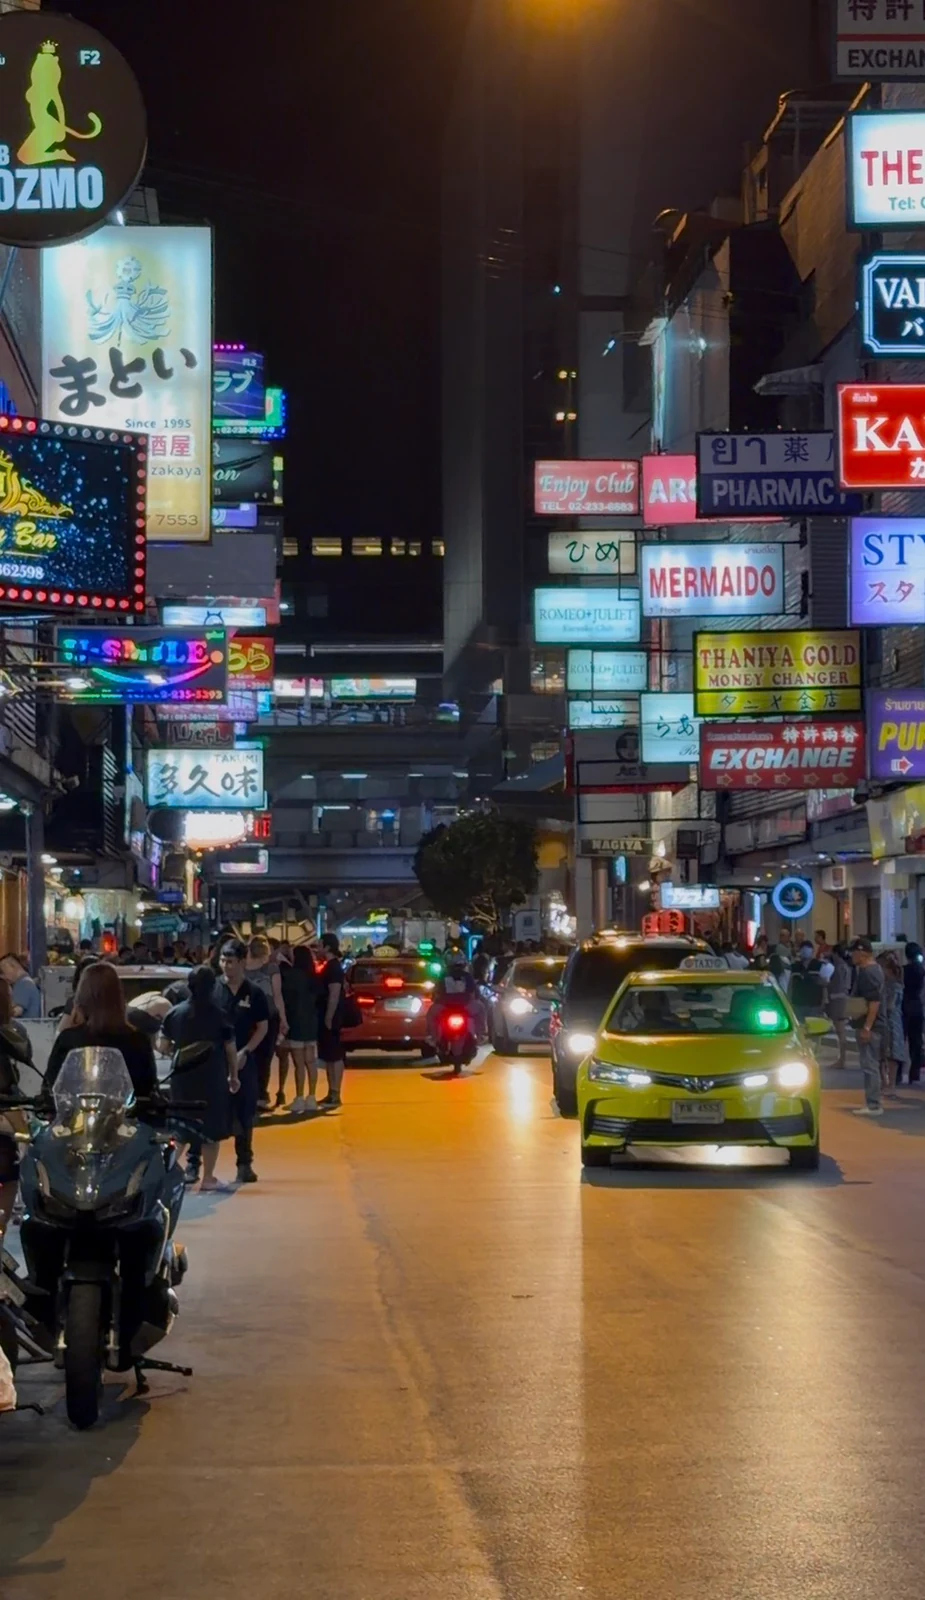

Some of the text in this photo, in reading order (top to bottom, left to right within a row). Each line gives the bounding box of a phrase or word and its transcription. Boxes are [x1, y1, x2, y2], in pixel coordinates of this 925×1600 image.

[80, 50, 101, 65] F2
[860, 149, 923, 186] THE
[888, 196, 916, 210] Tel:
[49, 346, 198, 417] まとい
[125, 418, 192, 429] Since 1995
[711, 436, 768, 466] ยา
[539, 471, 635, 501] Enjoy Club
[156, 514, 199, 527] 7553
[14, 521, 57, 549] Bar
[565, 540, 620, 563] ひめ
[649, 564, 776, 600] MERMAIDO
[700, 645, 857, 669] THANIYA GOLD
[708, 671, 849, 687] MONEY CHANGER
[214, 753, 259, 764] TAKUMI
[710, 747, 856, 770] EXCHANGE
[154, 763, 258, 800] 多久味
[592, 839, 643, 851] NAGIYA
